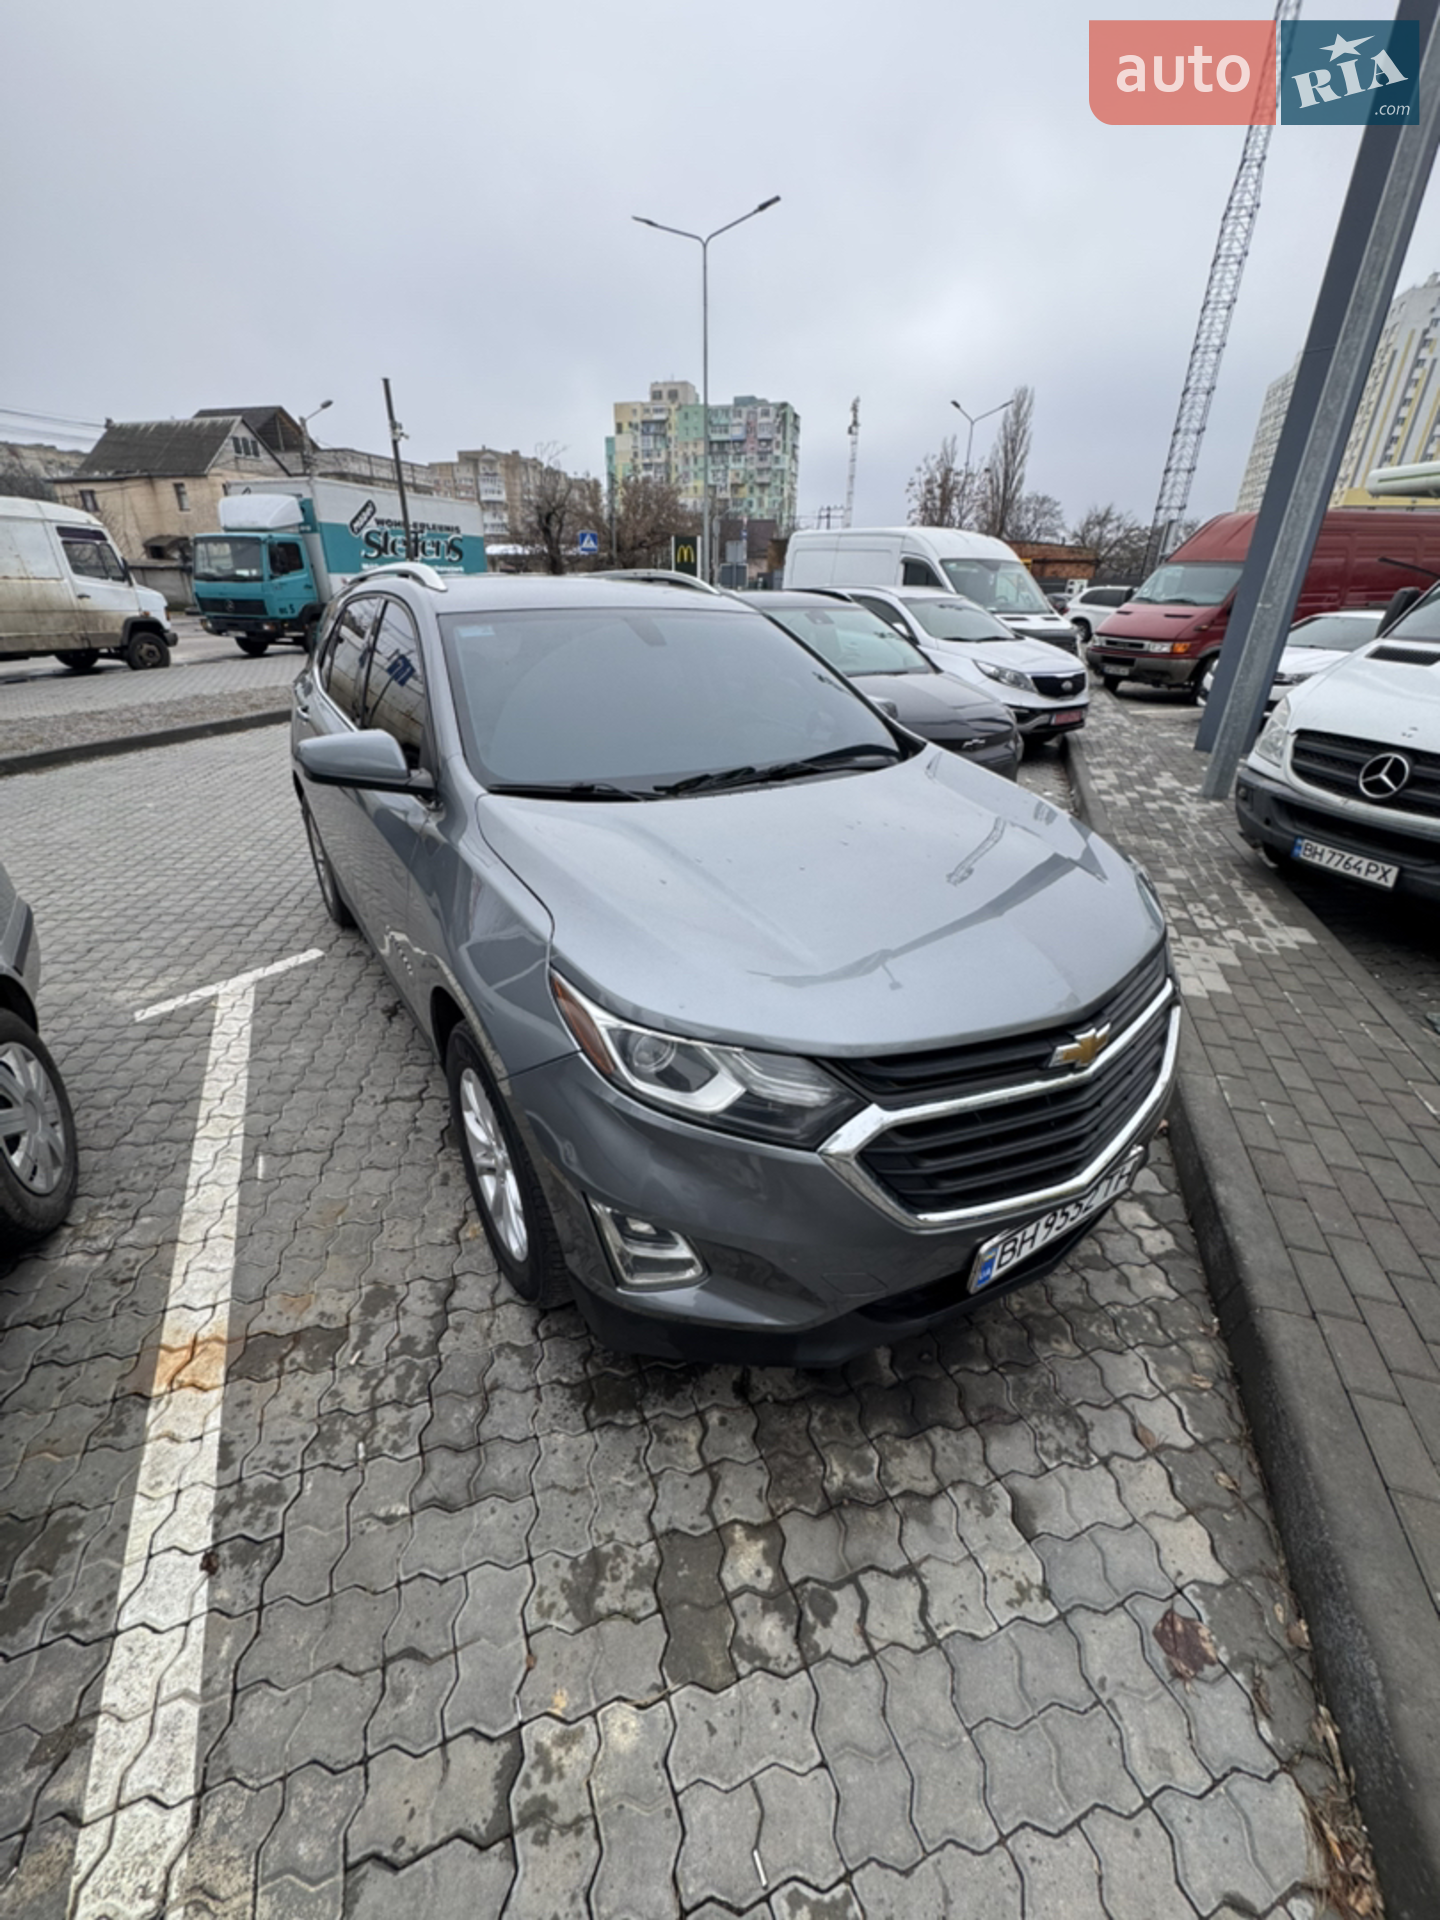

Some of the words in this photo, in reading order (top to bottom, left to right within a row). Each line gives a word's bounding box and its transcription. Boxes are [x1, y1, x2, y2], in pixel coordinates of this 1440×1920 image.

[1302, 842, 1325, 861] BH
[1326, 850, 1364, 875] 7764
[1364, 861, 1393, 883] PX
[997, 1222, 1041, 1270] BH
